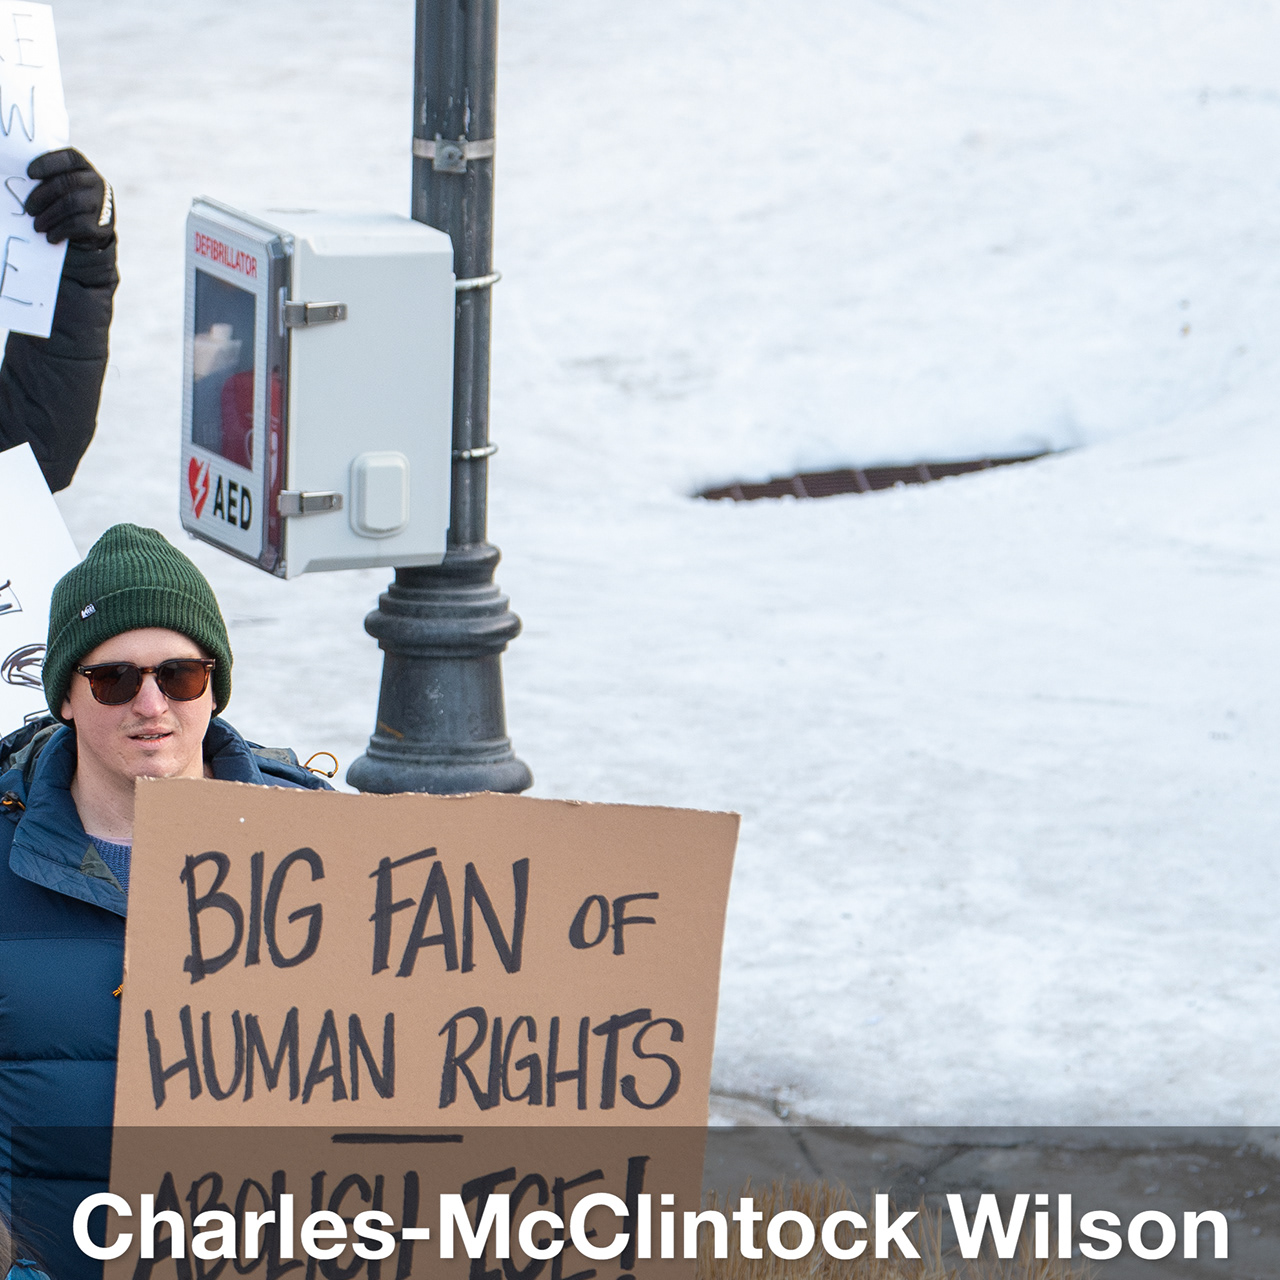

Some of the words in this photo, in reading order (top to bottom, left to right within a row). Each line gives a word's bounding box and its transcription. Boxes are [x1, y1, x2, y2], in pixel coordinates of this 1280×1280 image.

[195, 232, 258, 278] DEFIBRILLATOR
[213, 474, 253, 531] AED
[179, 846, 325, 984] BIG
[367, 846, 530, 978] FAN
[568, 891, 660, 955] OF
[144, 1005, 396, 1110] HUMAN
[437, 1005, 685, 1112] RIGHTS
